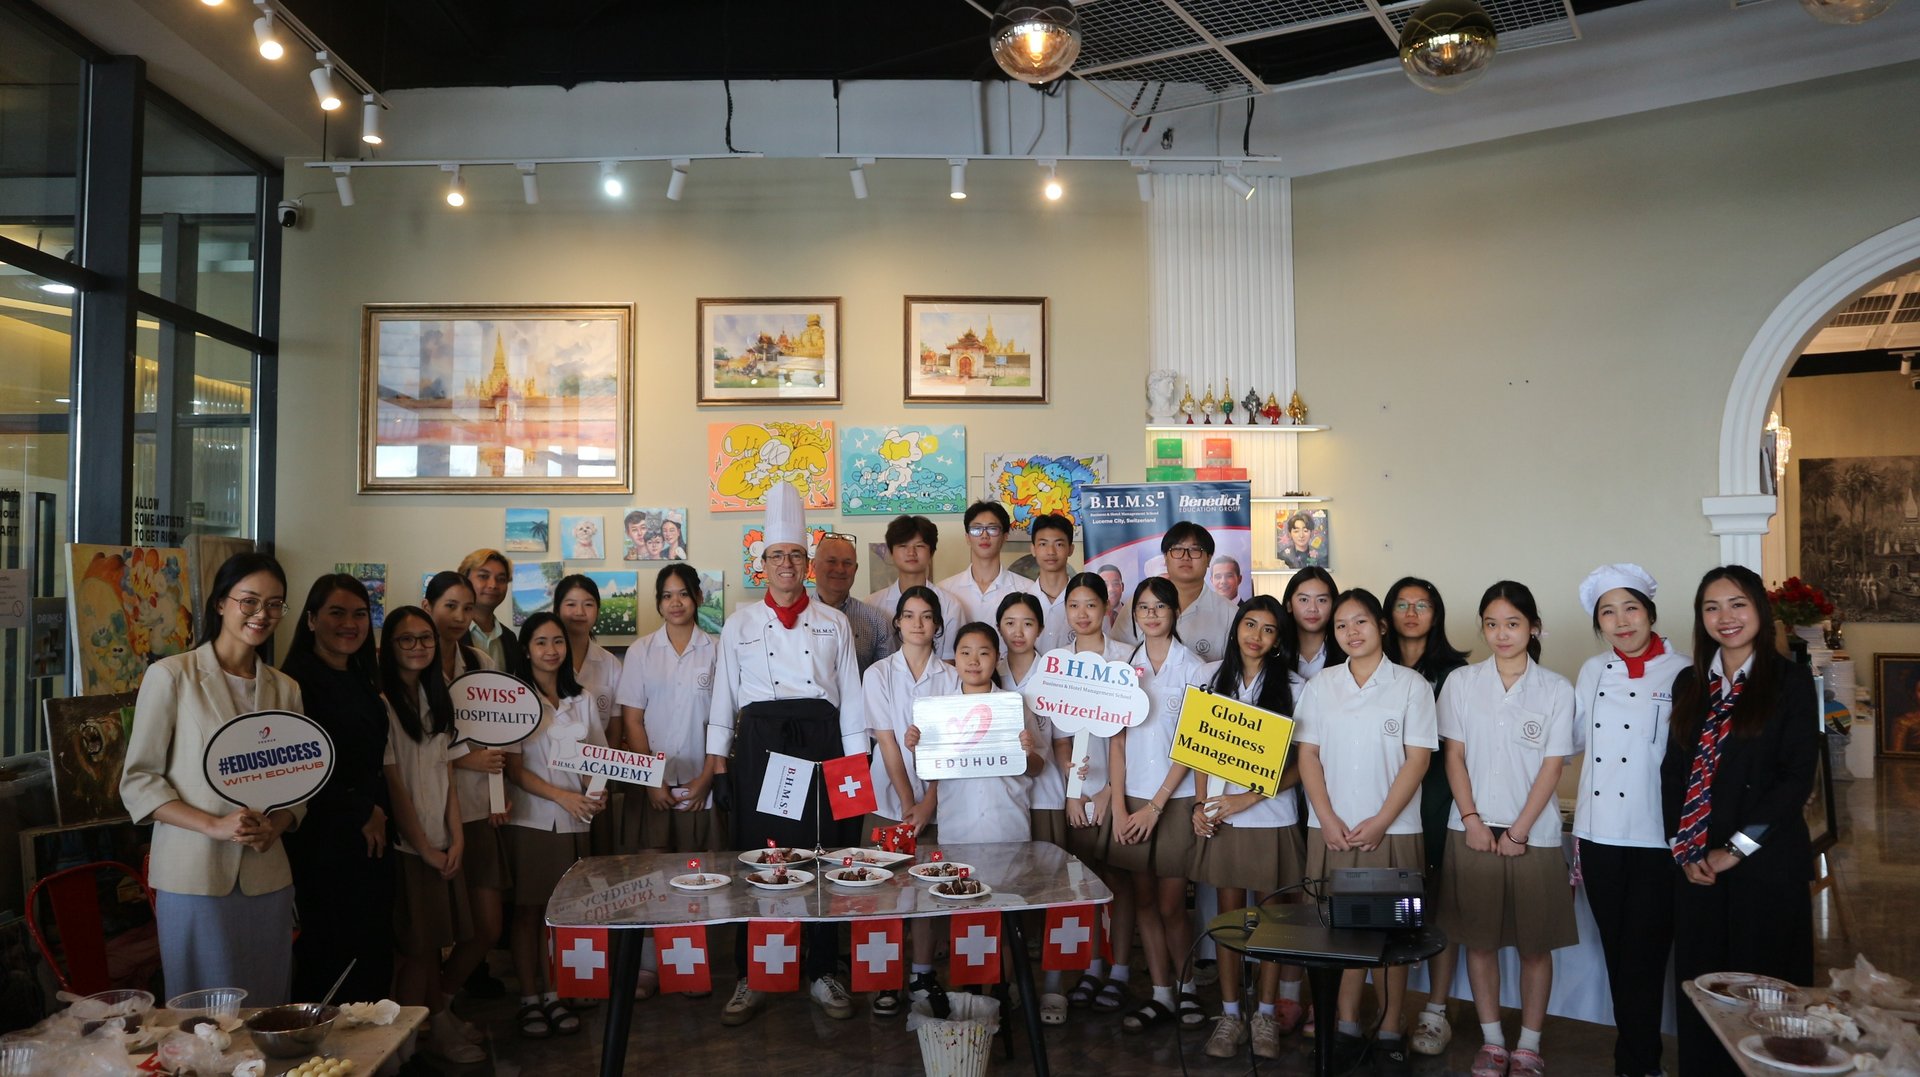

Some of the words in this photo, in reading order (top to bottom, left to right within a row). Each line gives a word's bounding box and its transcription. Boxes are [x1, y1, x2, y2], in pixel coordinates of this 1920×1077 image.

[134, 496, 159, 510] ALLOW
[1090, 494, 1160, 509] B.H.M.S.
[134, 512, 154, 526] SOME
[155, 515, 185, 528] ARTISTS
[134, 529, 144, 541] TO
[145, 530, 159, 542] GET
[160, 531, 177, 543] RICH
[1045, 655, 1134, 687] B.H.M.S.
[467, 686, 516, 704] SWISS
[1083, 687, 1114, 698] Management
[1036, 696, 1133, 726] Switzerland
[1211, 704, 1262, 732] Global
[1198, 720, 1265, 754] Business
[218, 741, 322, 776] #EDUSUCCESS
[582, 745, 655, 769] CULINARY
[935, 755, 1008, 769] EDUHUB
[1177, 733, 1277, 780] Management
[223, 773, 262, 787] WITH
[265, 761, 325, 778] EDUHUB
[552, 759, 576, 769] B.H.M.S.
[579, 760, 653, 783] ACADEMY
[778, 767, 796, 810] B.H.M.S.
